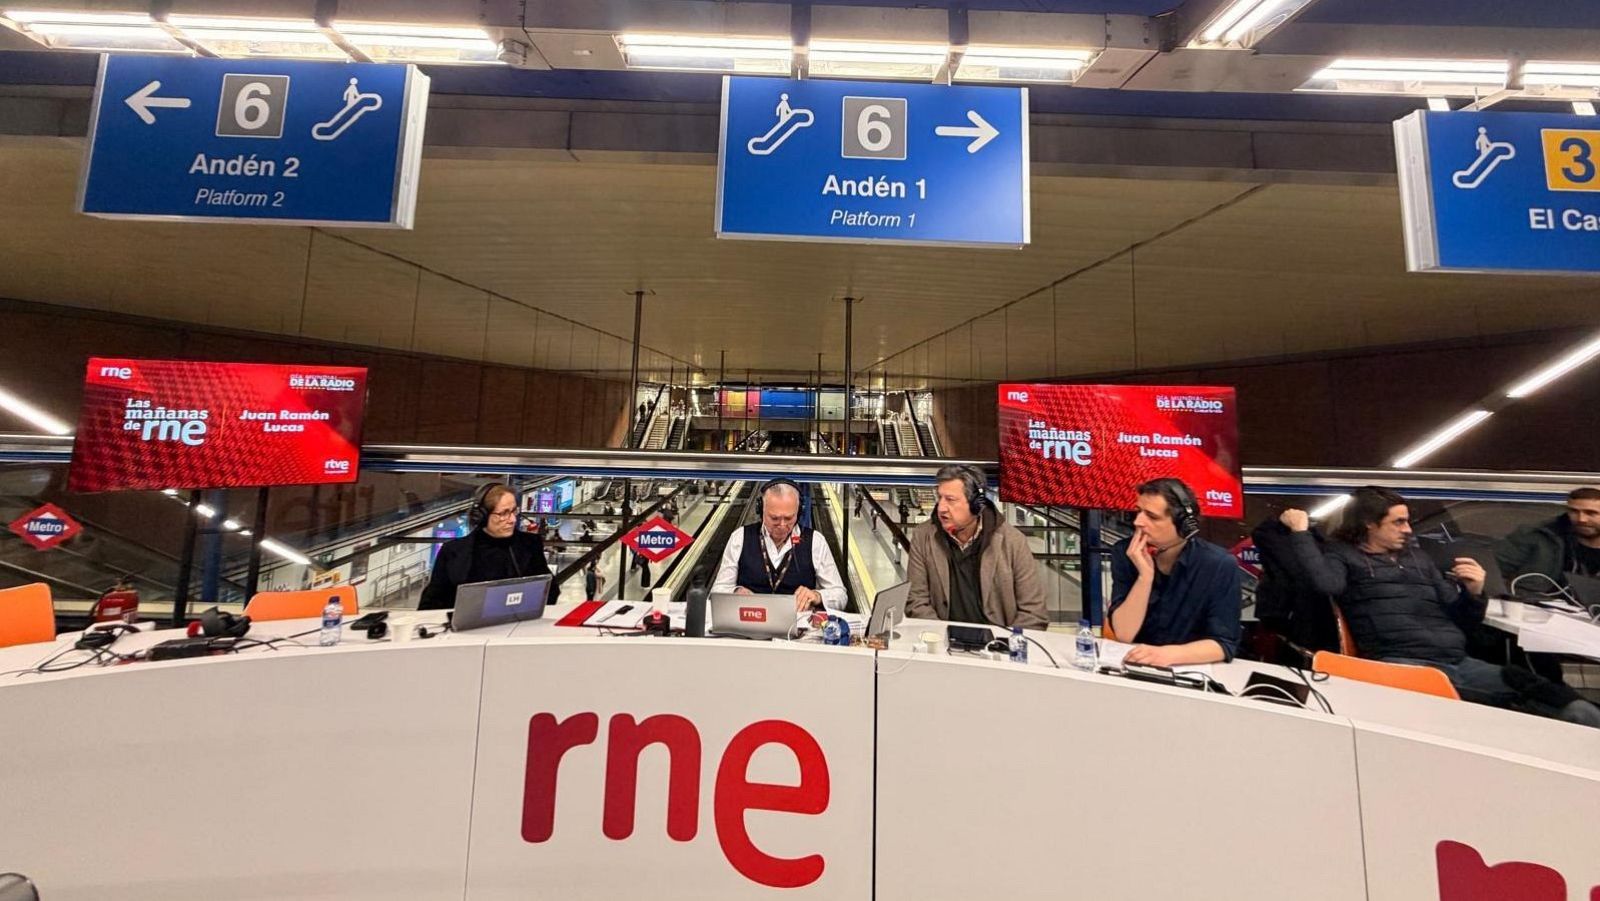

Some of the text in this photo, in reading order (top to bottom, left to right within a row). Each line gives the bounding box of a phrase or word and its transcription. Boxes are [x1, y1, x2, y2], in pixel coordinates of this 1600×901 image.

[234, 82, 271, 131] 6
[857, 104, 892, 152] 6
[189, 154, 300, 178] Andén 2
[1559, 137, 1596, 184] 3
[822, 174, 926, 200] Andén 1
[194, 188, 285, 207] Platform 2
[830, 209, 916, 228] Platform 1
[1529, 208, 1554, 229] El
[101, 366, 131, 380] rne
[290, 378, 355, 388] DE LA RADIO
[126, 398, 151, 409] Las
[1007, 391, 1029, 403] rne
[1157, 400, 1223, 409] DE LA RADIO
[124, 405, 208, 420] mañanas
[239, 408, 330, 421] Juan Ramón
[263, 422, 305, 433] Lucas
[1028, 418, 1046, 429] Las
[123, 418, 207, 445] de rne
[1028, 427, 1091, 442] mañanas
[1117, 431, 1202, 445] Juan Ramón
[1029, 439, 1092, 465] de rne
[1140, 446, 1179, 458] Lucas
[325, 459, 349, 470] rtve
[1206, 490, 1232, 503] rtve
[28, 520, 63, 535] Metro
[639, 534, 674, 546] Metro
[743, 609, 763, 619] rne
[521, 711, 831, 889] rne
